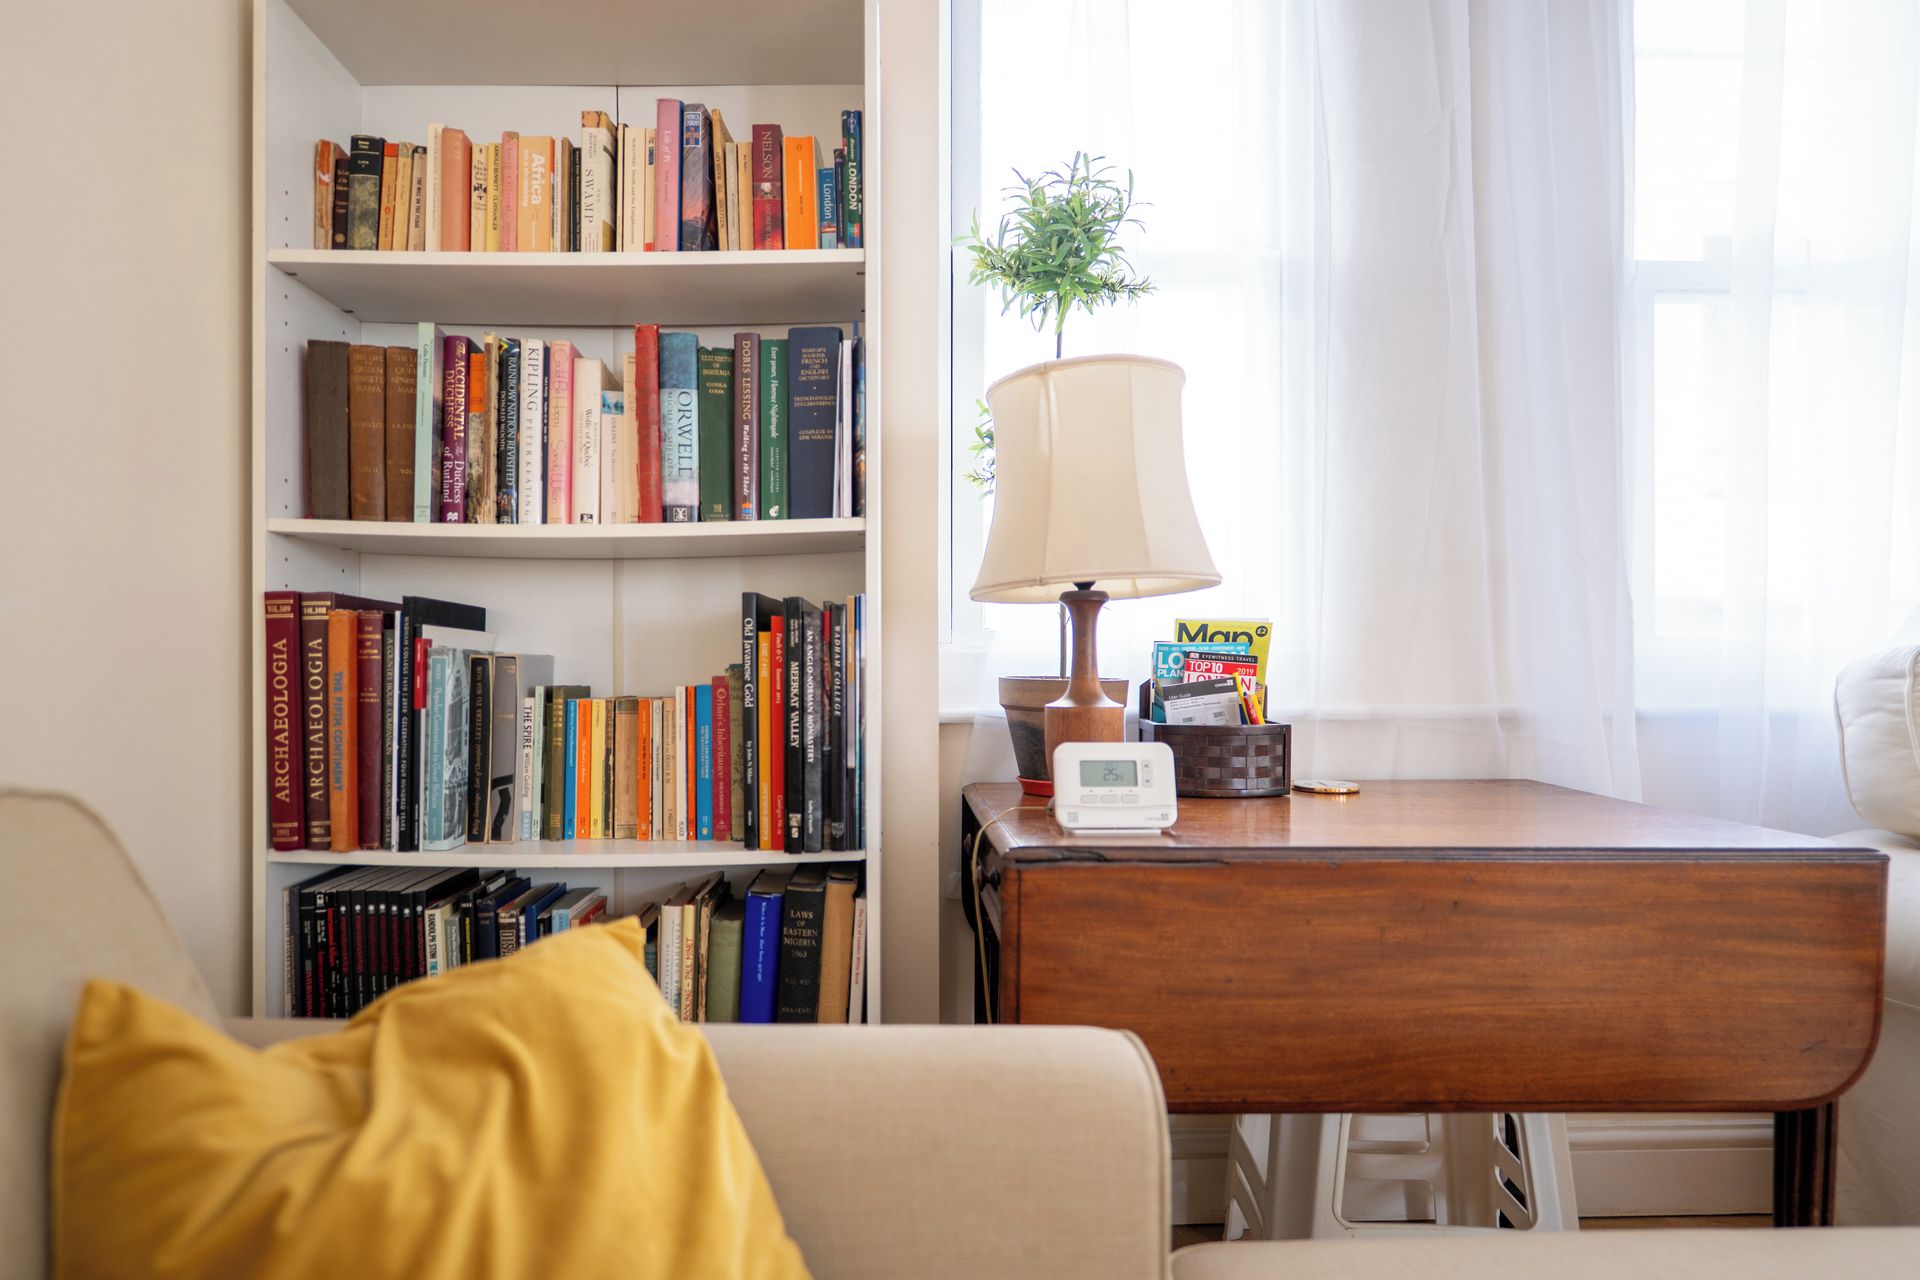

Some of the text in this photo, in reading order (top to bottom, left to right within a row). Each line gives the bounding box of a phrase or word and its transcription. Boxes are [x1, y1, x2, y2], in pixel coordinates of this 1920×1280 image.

[662, 146, 671, 154] of
[664, 131, 672, 145] Life
[762, 131, 772, 178] NELSON
[531, 153, 545, 204] Africa
[584, 169, 594, 223] SWAMP
[847, 162, 858, 210] LONDON
[823, 184, 833, 218] London
[770, 347, 778, 359] Ever
[445, 370, 455, 427] DUCHESS
[454, 341, 465, 440] The ACCIDENTAL
[527, 348, 539, 411] KIPLING
[742, 340, 750, 420] DORIS LESSING
[770, 380, 778, 403] Florence
[506, 357, 517, 485] RAINBOW NATION REVISITED
[666, 391, 674, 434] MICHAEL
[770, 404, 778, 438] Nightingale
[583, 409, 592, 469] Wolfe of Quebec
[678, 391, 693, 478] ORWELL
[443, 447, 454, 502] of Rutland
[742, 453, 749, 461] in
[454, 461, 465, 504] Duchess
[1177, 622, 1254, 647] Map
[1257, 627, 1268, 636] £2
[744, 618, 753, 708] Old Javanese Gold
[433, 687, 443, 713] Popular
[790, 661, 800, 748] MEERKAT VALLEY
[806, 630, 814, 763] AN ANGLO-NORMAN MONASTERY
[272, 638, 290, 802] ARCHAEOLOGIA
[307, 638, 324, 801] ARCHAEOLOGIA
[334, 672, 344, 792] THE FIFTH CONTINENT
[432, 714, 442, 752] Contention
[523, 706, 532, 749] THE SPIRE
[432, 763, 440, 783] Great
[716, 728, 726, 779] Inheritance
[431, 784, 440, 809] Britain
[523, 775, 531, 798] Golding
[428, 913, 437, 942] RANDOLPH
[783, 927, 818, 937] EASTERN
[790, 910, 814, 919] LAWS
[429, 944, 438, 959] STOW
[783, 938, 816, 947] NIGERIA
